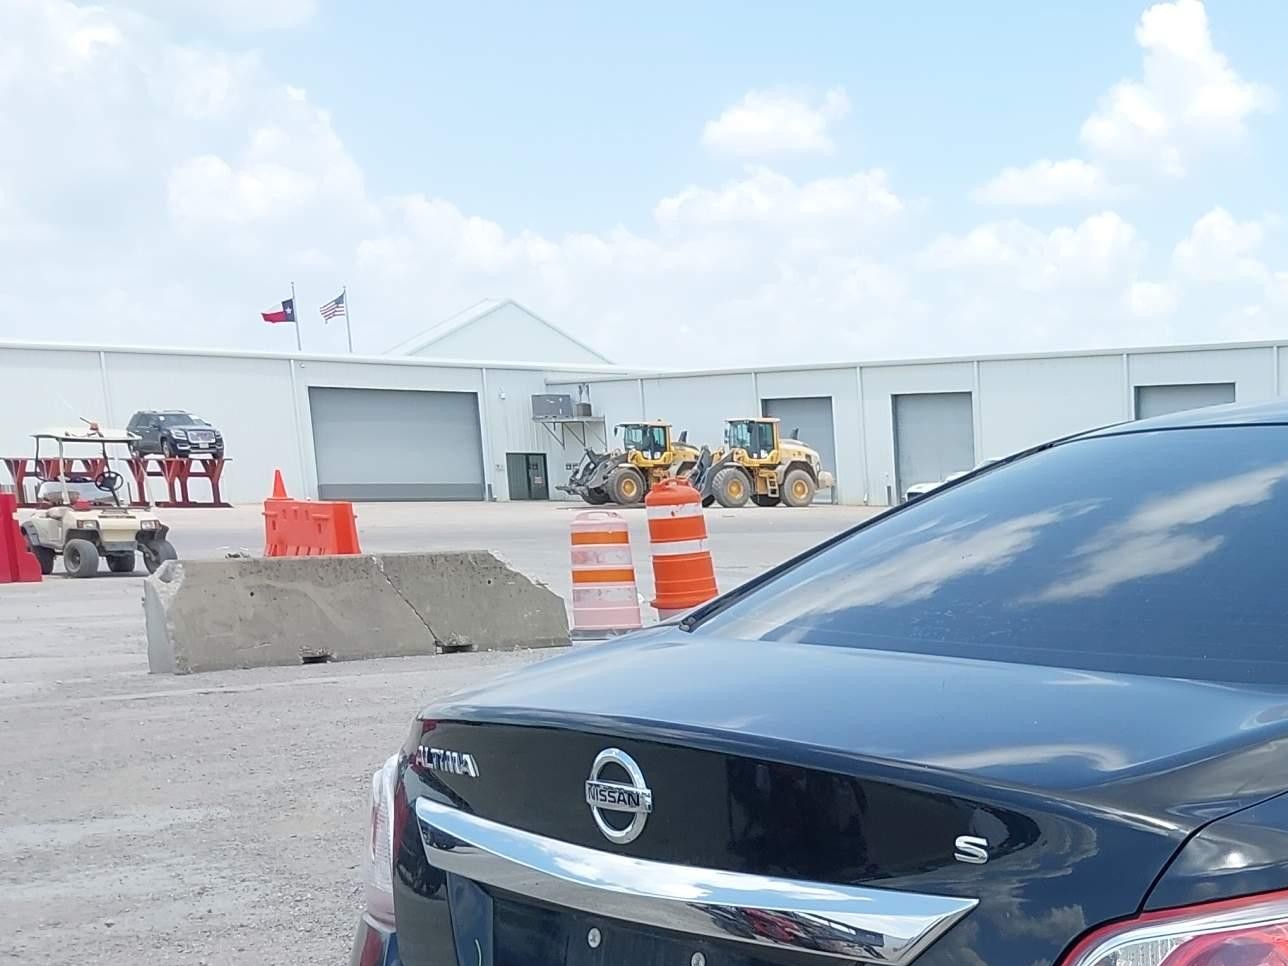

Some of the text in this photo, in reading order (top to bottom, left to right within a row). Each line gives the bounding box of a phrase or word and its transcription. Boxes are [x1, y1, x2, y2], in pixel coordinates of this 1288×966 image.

[416, 745, 480, 778] ALTIMA
[588, 783, 640, 807] NISSAN
[954, 835, 988, 864] S
